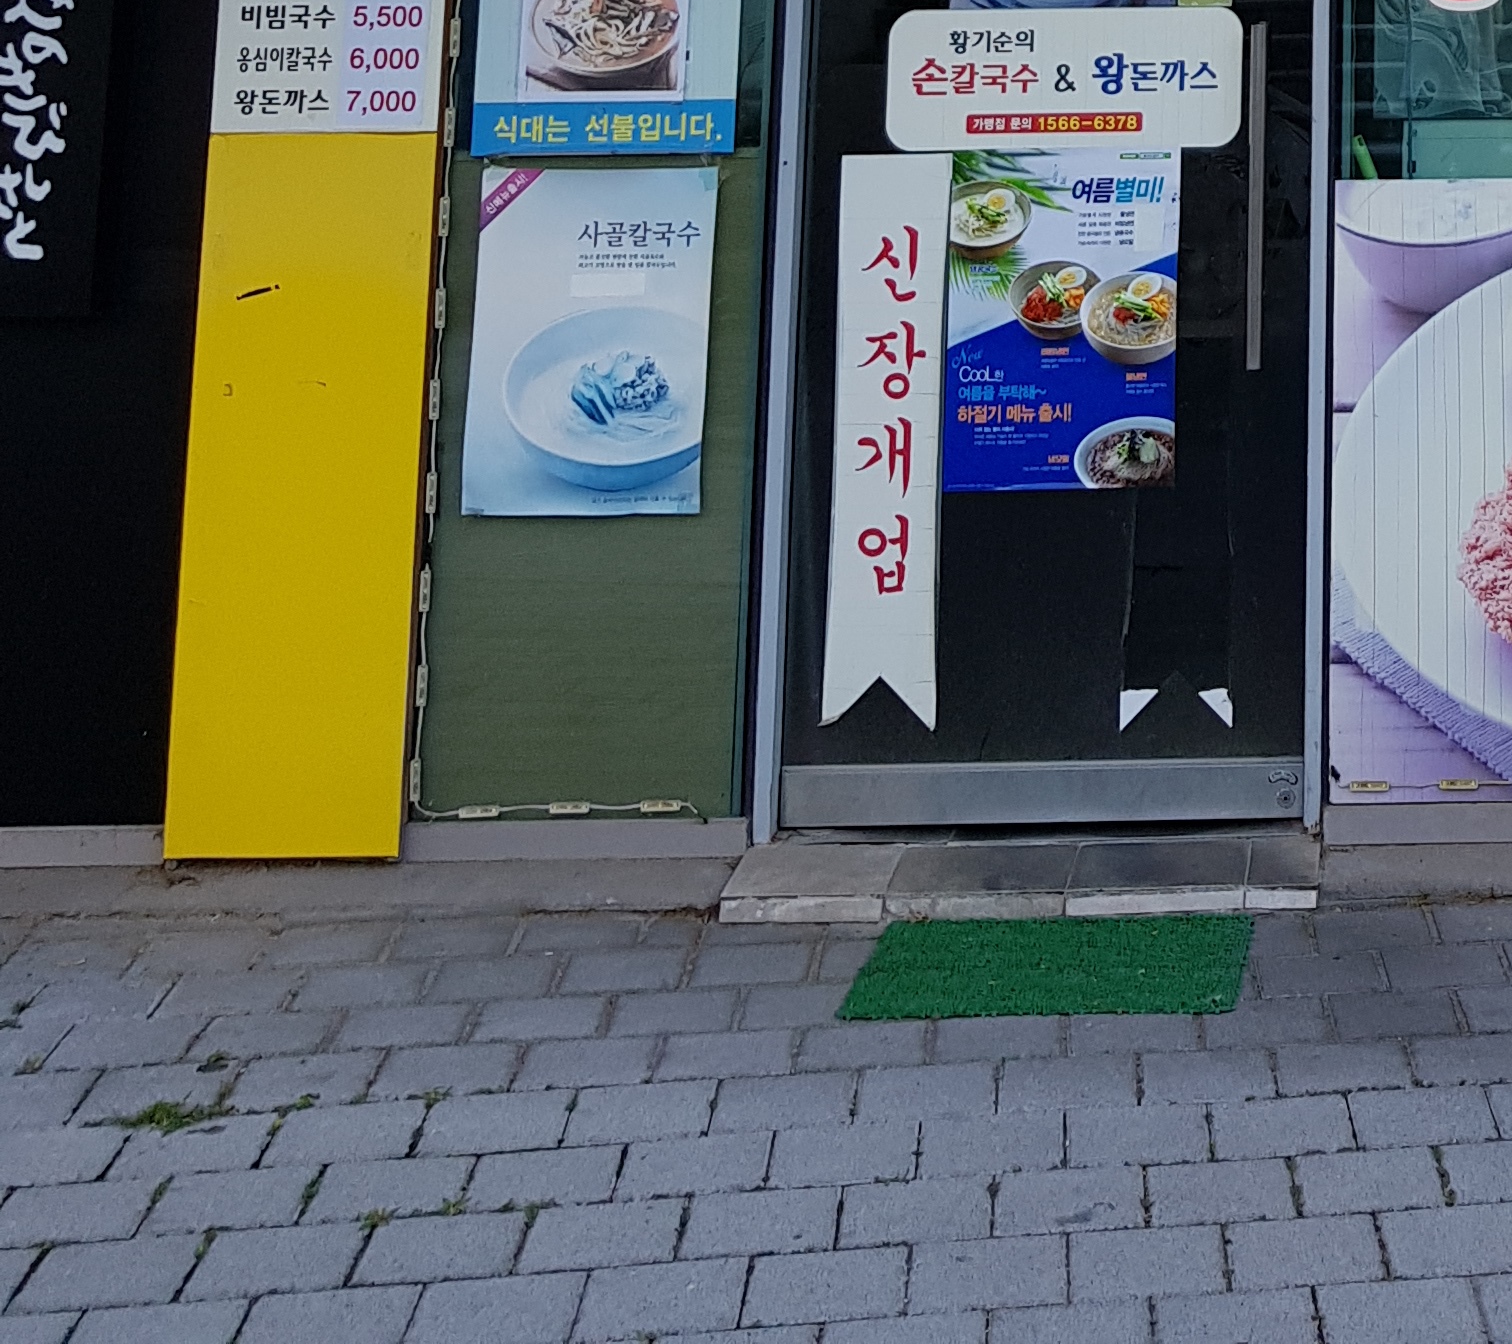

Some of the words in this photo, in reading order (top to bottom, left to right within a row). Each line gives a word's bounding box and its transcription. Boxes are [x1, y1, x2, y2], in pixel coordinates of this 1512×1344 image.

[240, 4, 336, 31] 비빔국수
[353, 6, 423, 31] 5,500
[949, 29, 1035, 54] 황기순의
[236, 46, 333, 73] 옹심이칼국수
[349, 48, 420, 73] 6,000
[912, 57, 1039, 96] 손칼국수
[1054, 63, 1077, 92] &
[1092, 52, 1218, 95] 왕돈까스
[233, 89, 330, 115] 왕돈까스
[346, 90, 416, 116] 7,000
[493, 114, 570, 143] 식대는
[585, 112, 722, 143] 선불입니다.
[973, 118, 1006, 131] 가맹점
[1010, 118, 1032, 130] 문의
[1037, 115, 1138, 131] 1566-6378
[1072, 176, 1164, 203] 여름별미!
[577, 220, 701, 248] 사골칼국수
[958, 385, 995, 401] 여름을
[855, 225, 926, 595] 신장개업
[957, 404, 1001, 424] 하절기
[1006, 404, 1036, 424] 메뉴
